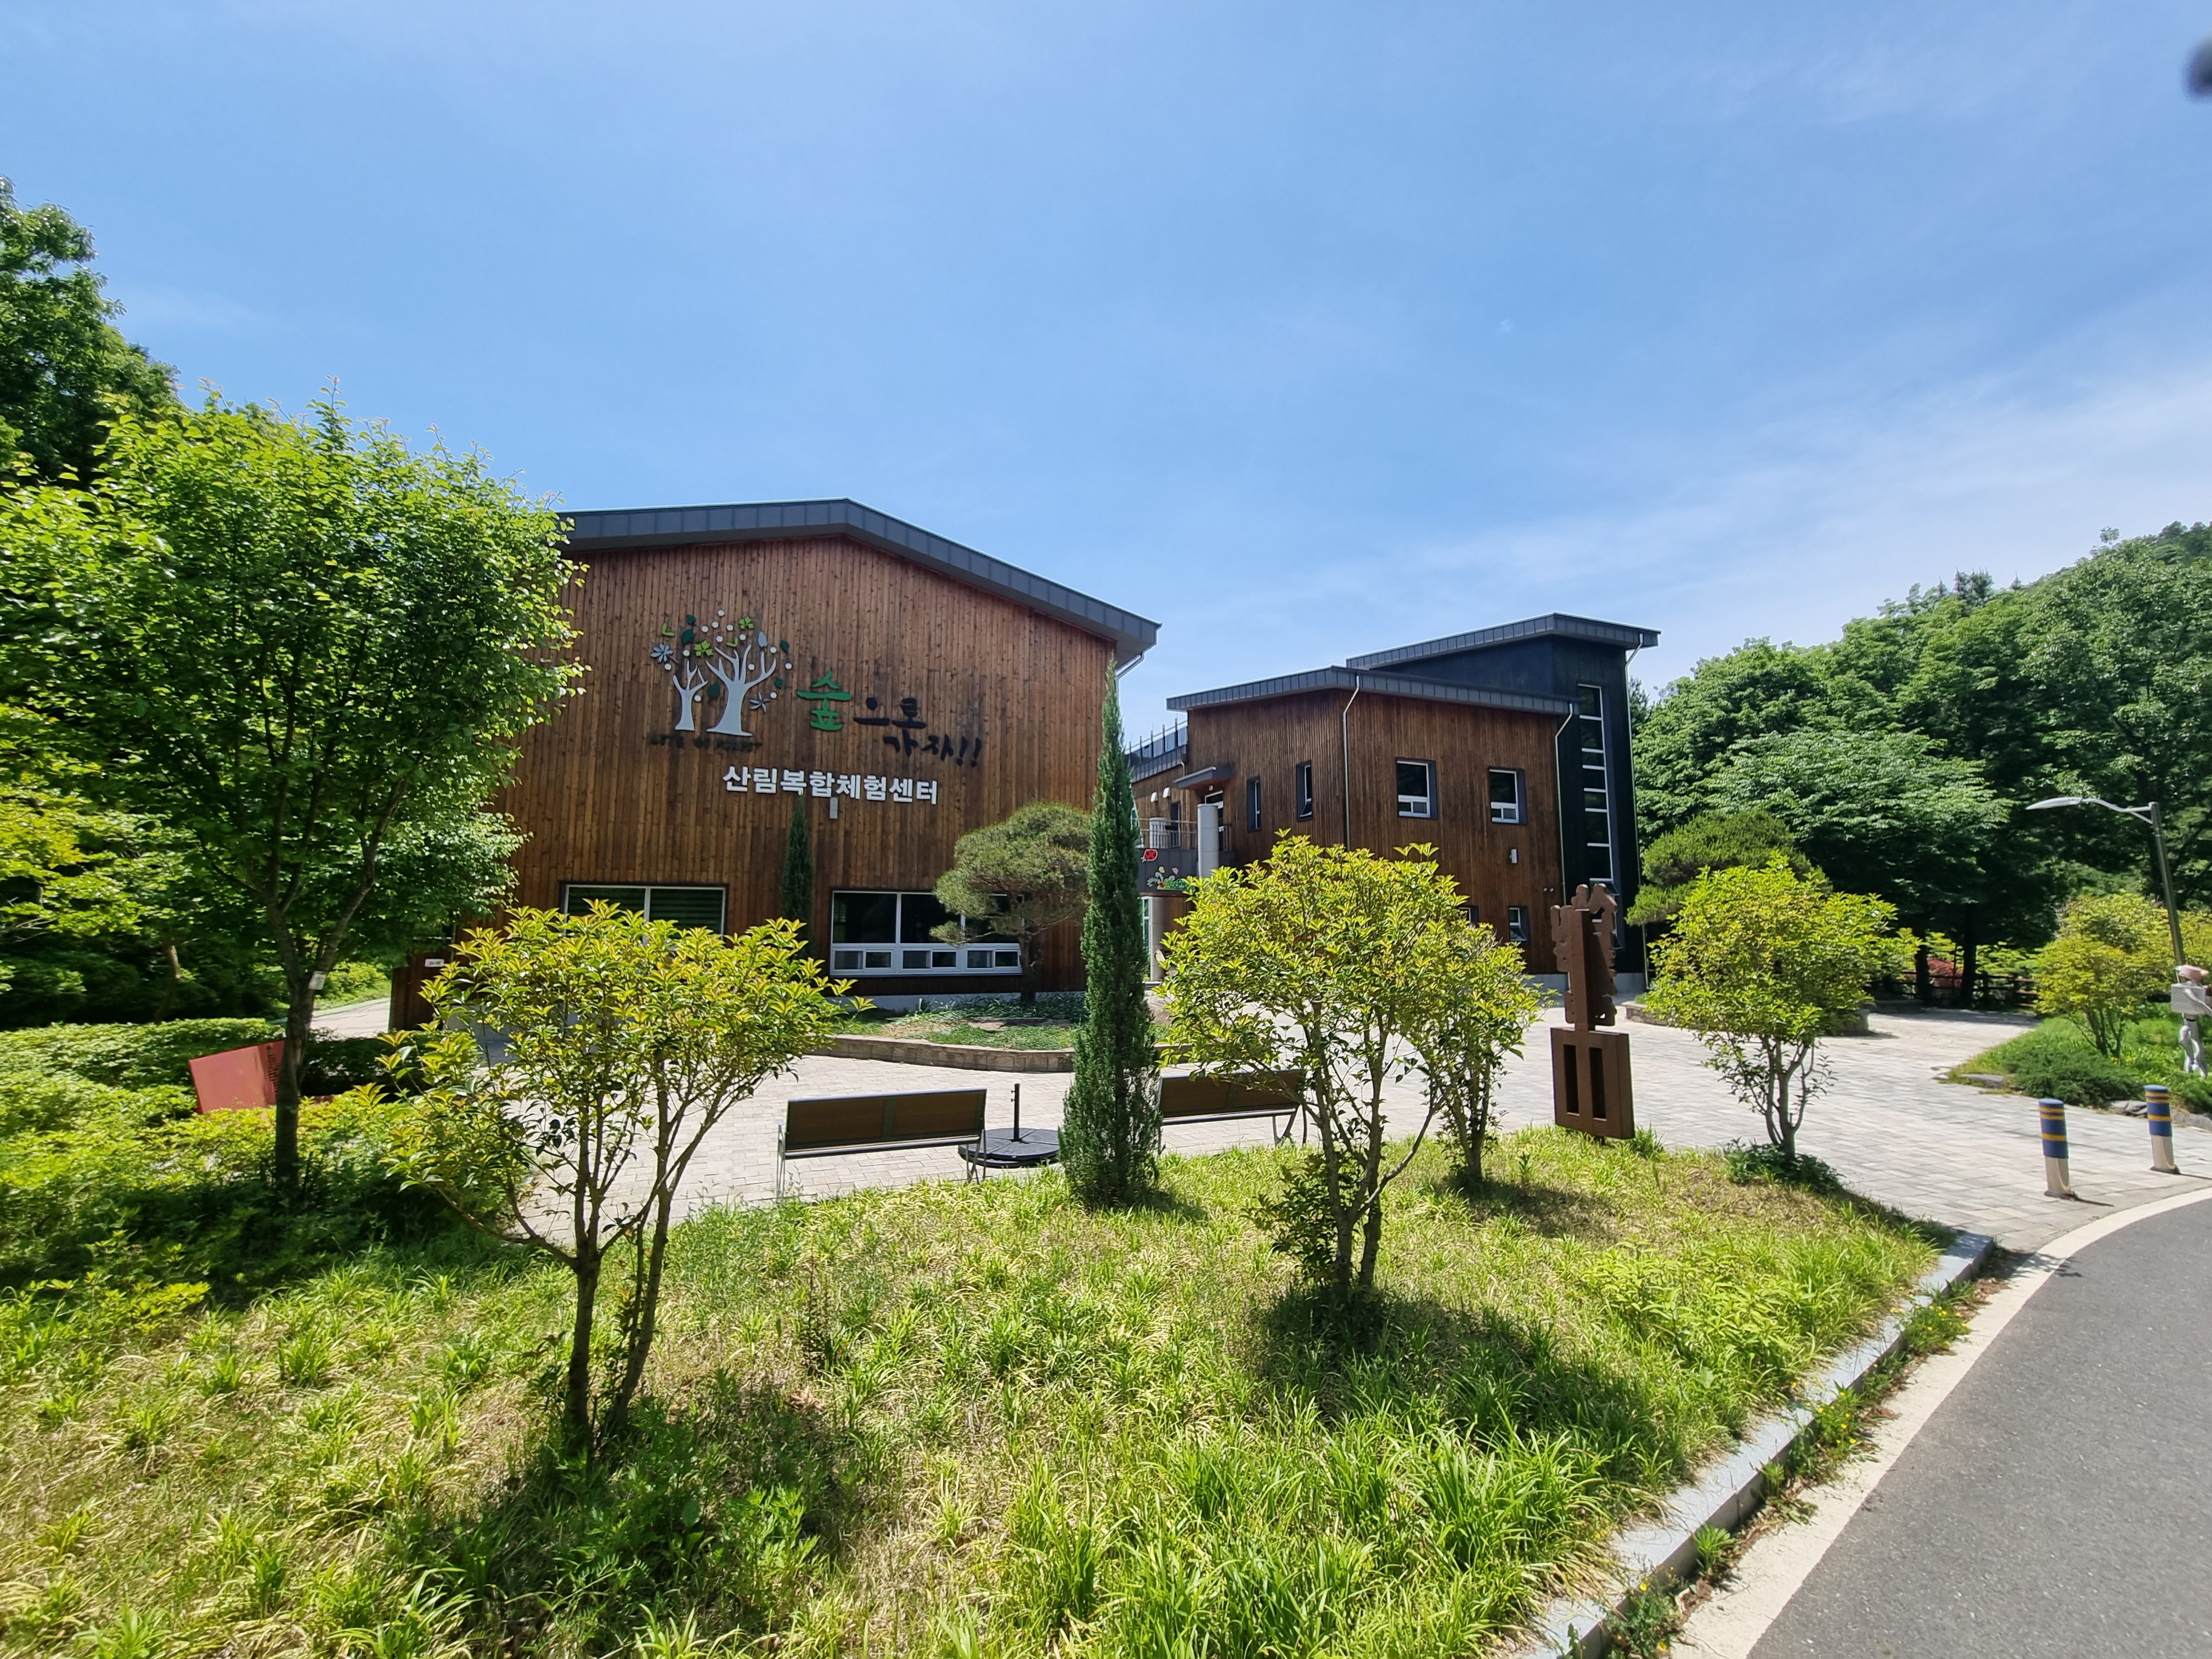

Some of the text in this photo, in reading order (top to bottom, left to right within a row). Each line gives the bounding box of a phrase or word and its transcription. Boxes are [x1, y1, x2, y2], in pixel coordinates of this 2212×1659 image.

[796, 670, 927, 732] 숲으로
[883, 727, 982, 768] 가자!!
[722, 765, 938, 805] 산림복합체험센터
